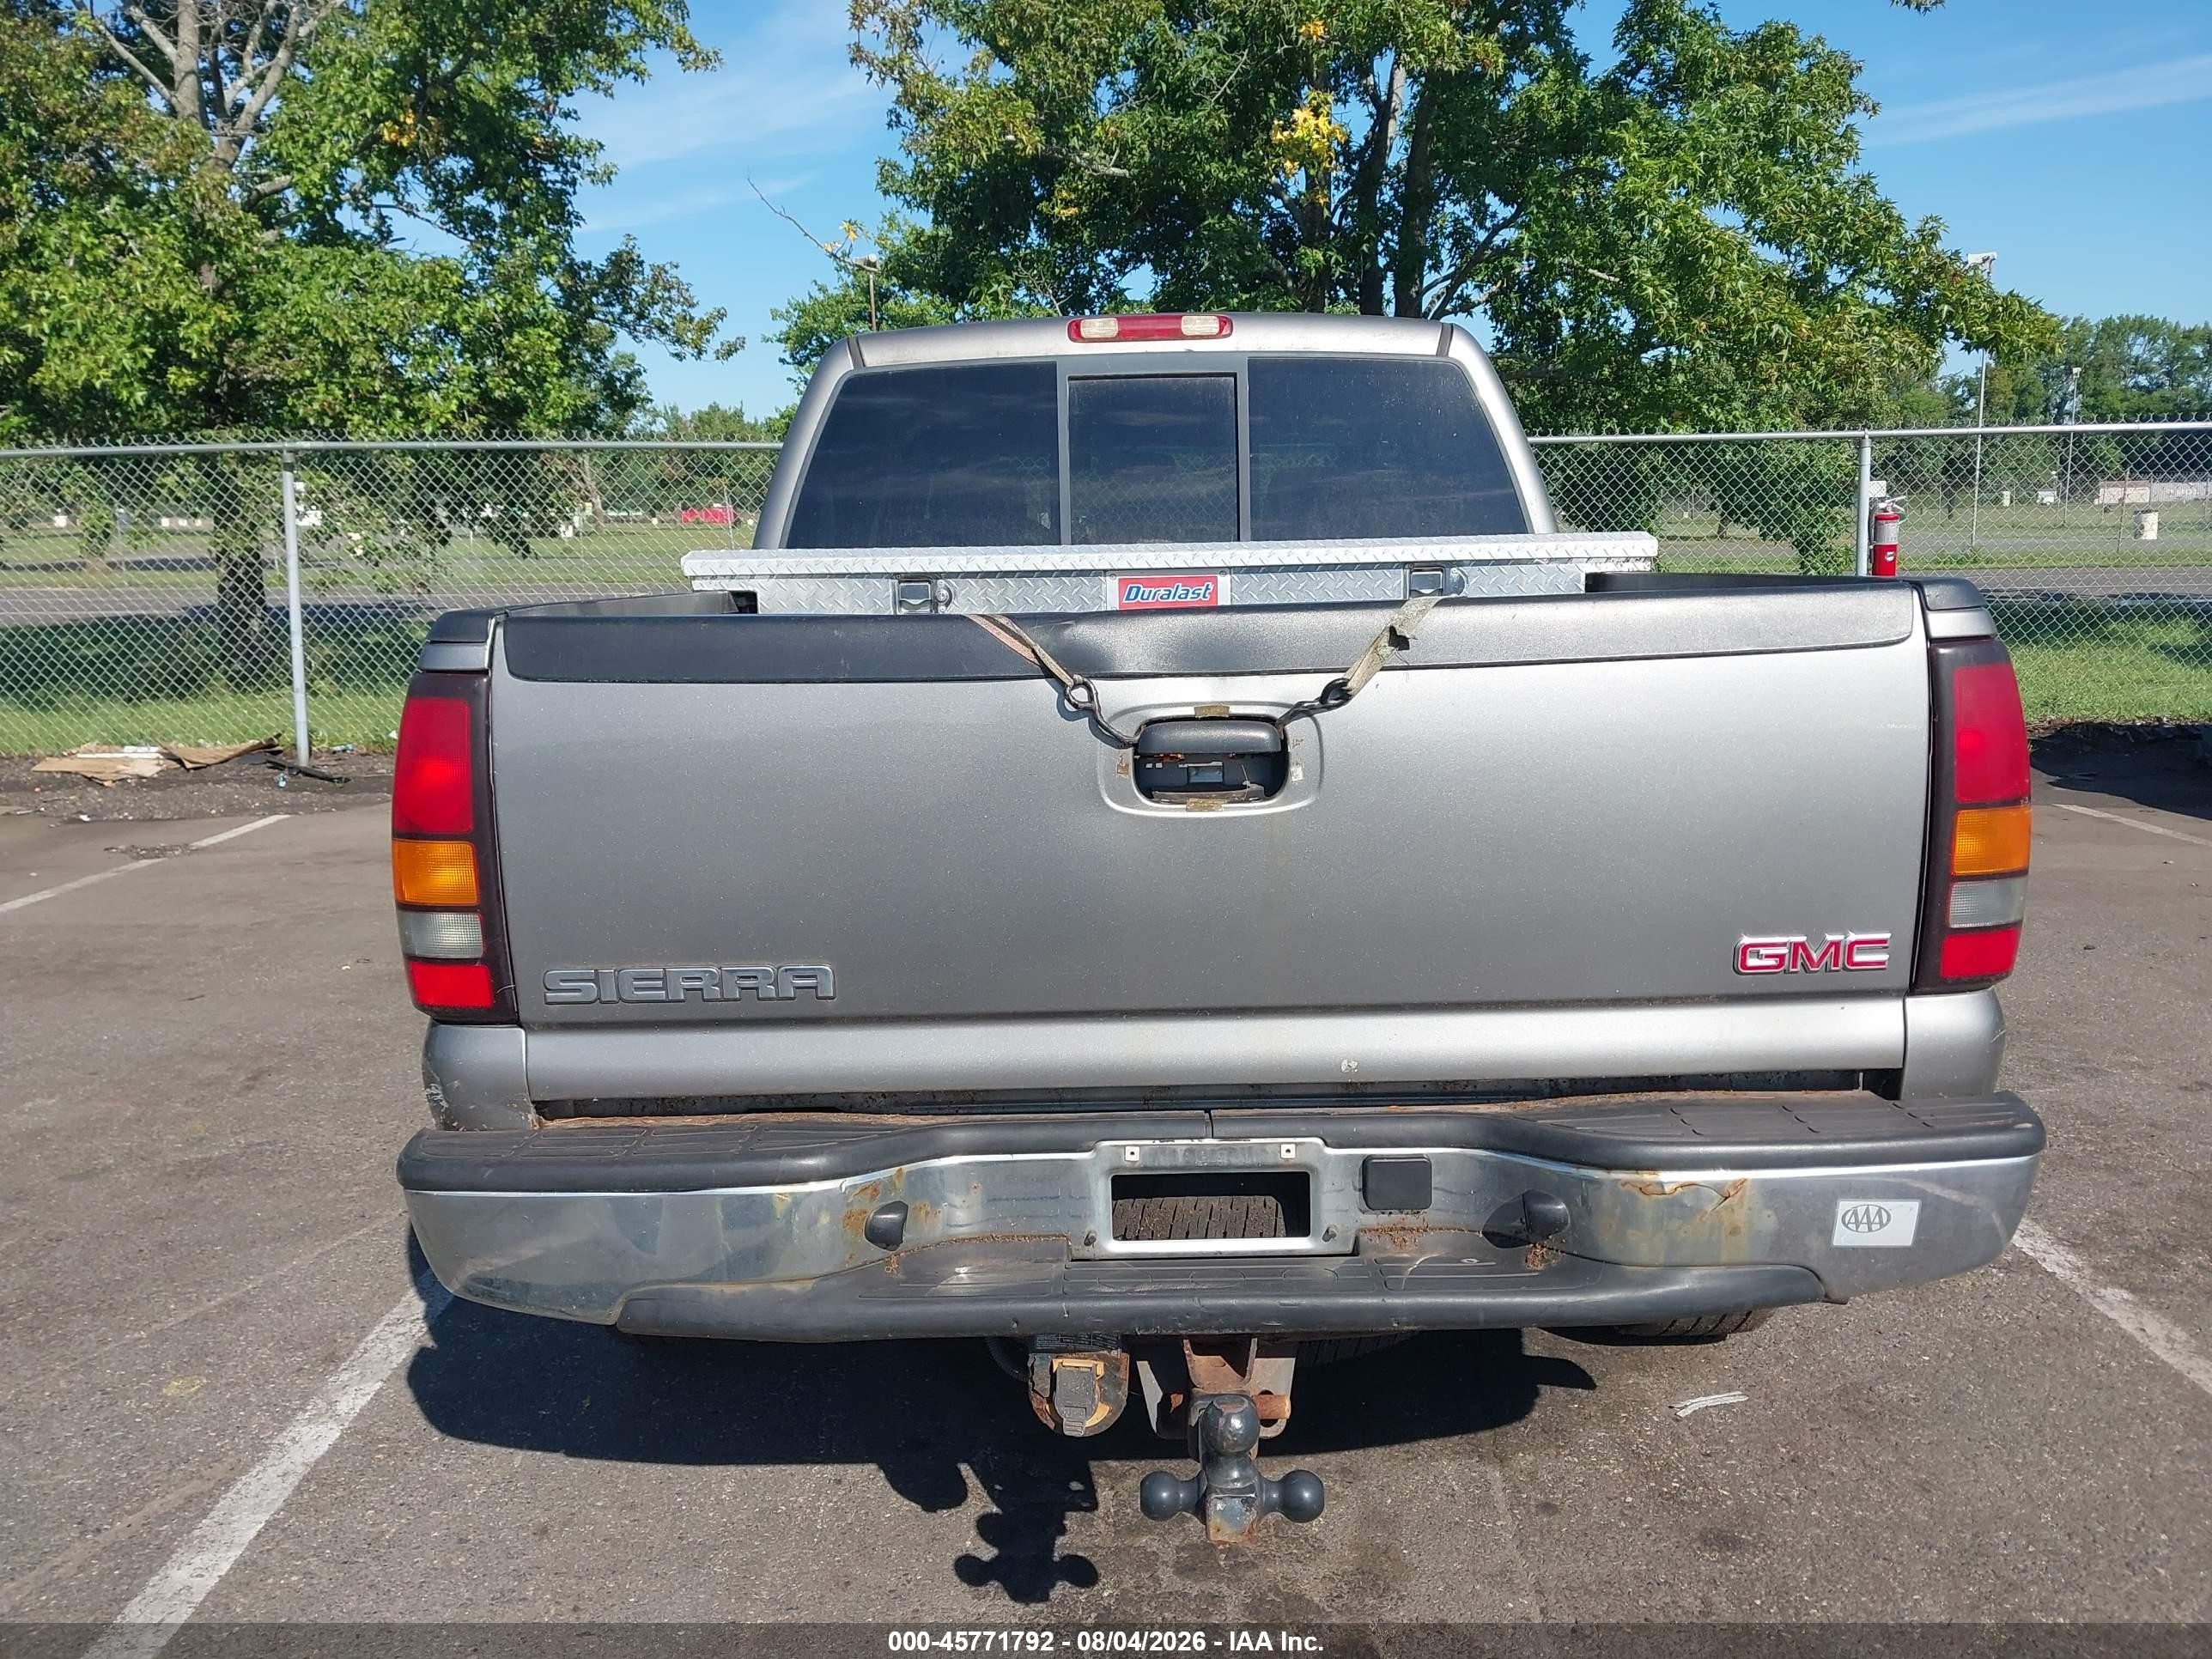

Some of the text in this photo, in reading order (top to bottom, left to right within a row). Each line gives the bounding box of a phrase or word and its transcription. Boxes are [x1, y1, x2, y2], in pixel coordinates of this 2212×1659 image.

[1123, 581, 1214, 603] Duralast
[1734, 932, 1892, 975] GMC
[543, 963, 837, 1005] SIERRA
[1845, 1205, 1887, 1232] AAA
